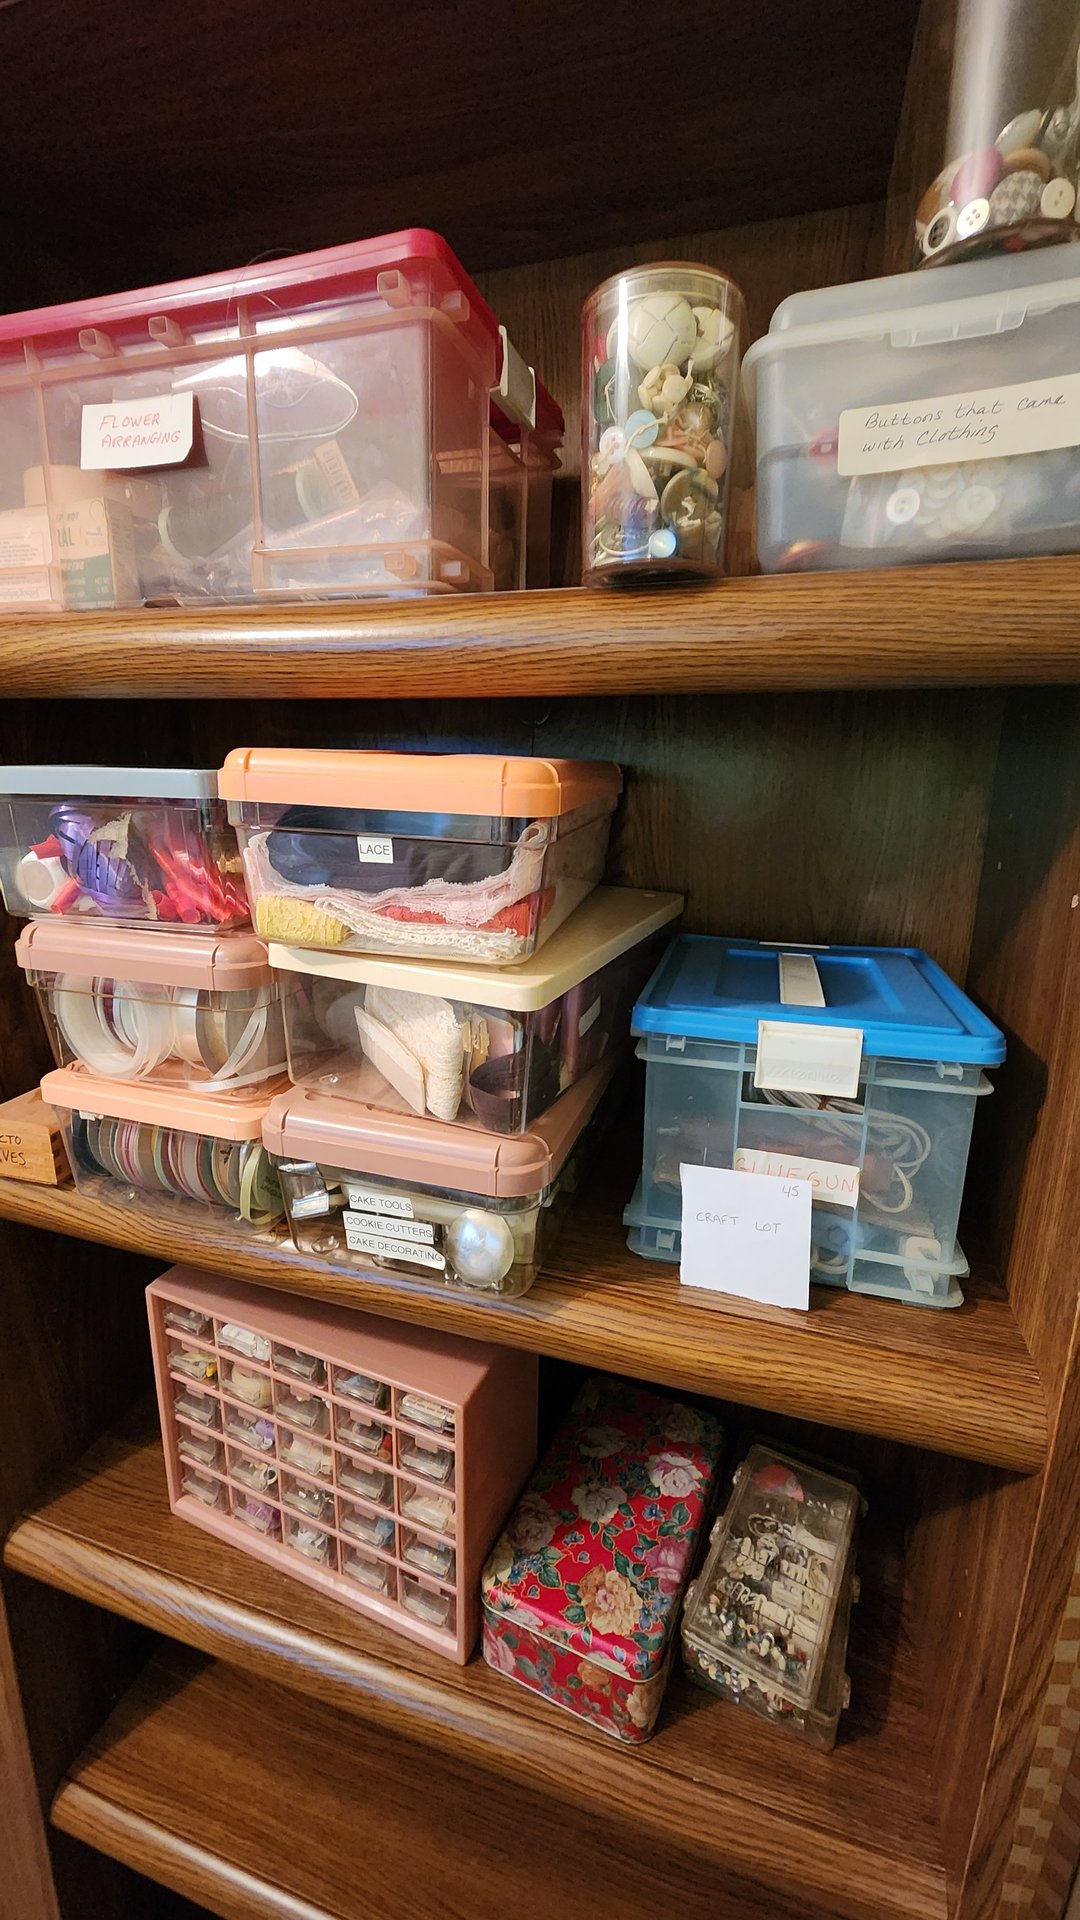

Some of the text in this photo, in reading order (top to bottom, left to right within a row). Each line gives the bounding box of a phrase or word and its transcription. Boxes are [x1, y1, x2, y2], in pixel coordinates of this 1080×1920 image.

[99, 413, 160, 431] FLOWER
[865, 409, 943, 429] Buttons
[954, 400, 1002, 419] that
[101, 430, 181, 448] ARRANGING
[862, 435, 904, 452] with
[359, 844, 391, 856] LACE
[0, 1150, 26, 1166] VES
[807, 1171, 855, 1193] GUN
[782, 1185, 799, 1198] 45
[349, 1194, 413, 1212] CAKE TOOLS
[346, 1216, 433, 1238] COOKIE CUTTERS
[696, 1212, 782, 1234] CRAFT LOT
[349, 1236, 443, 1262] CAKE DECORATING
